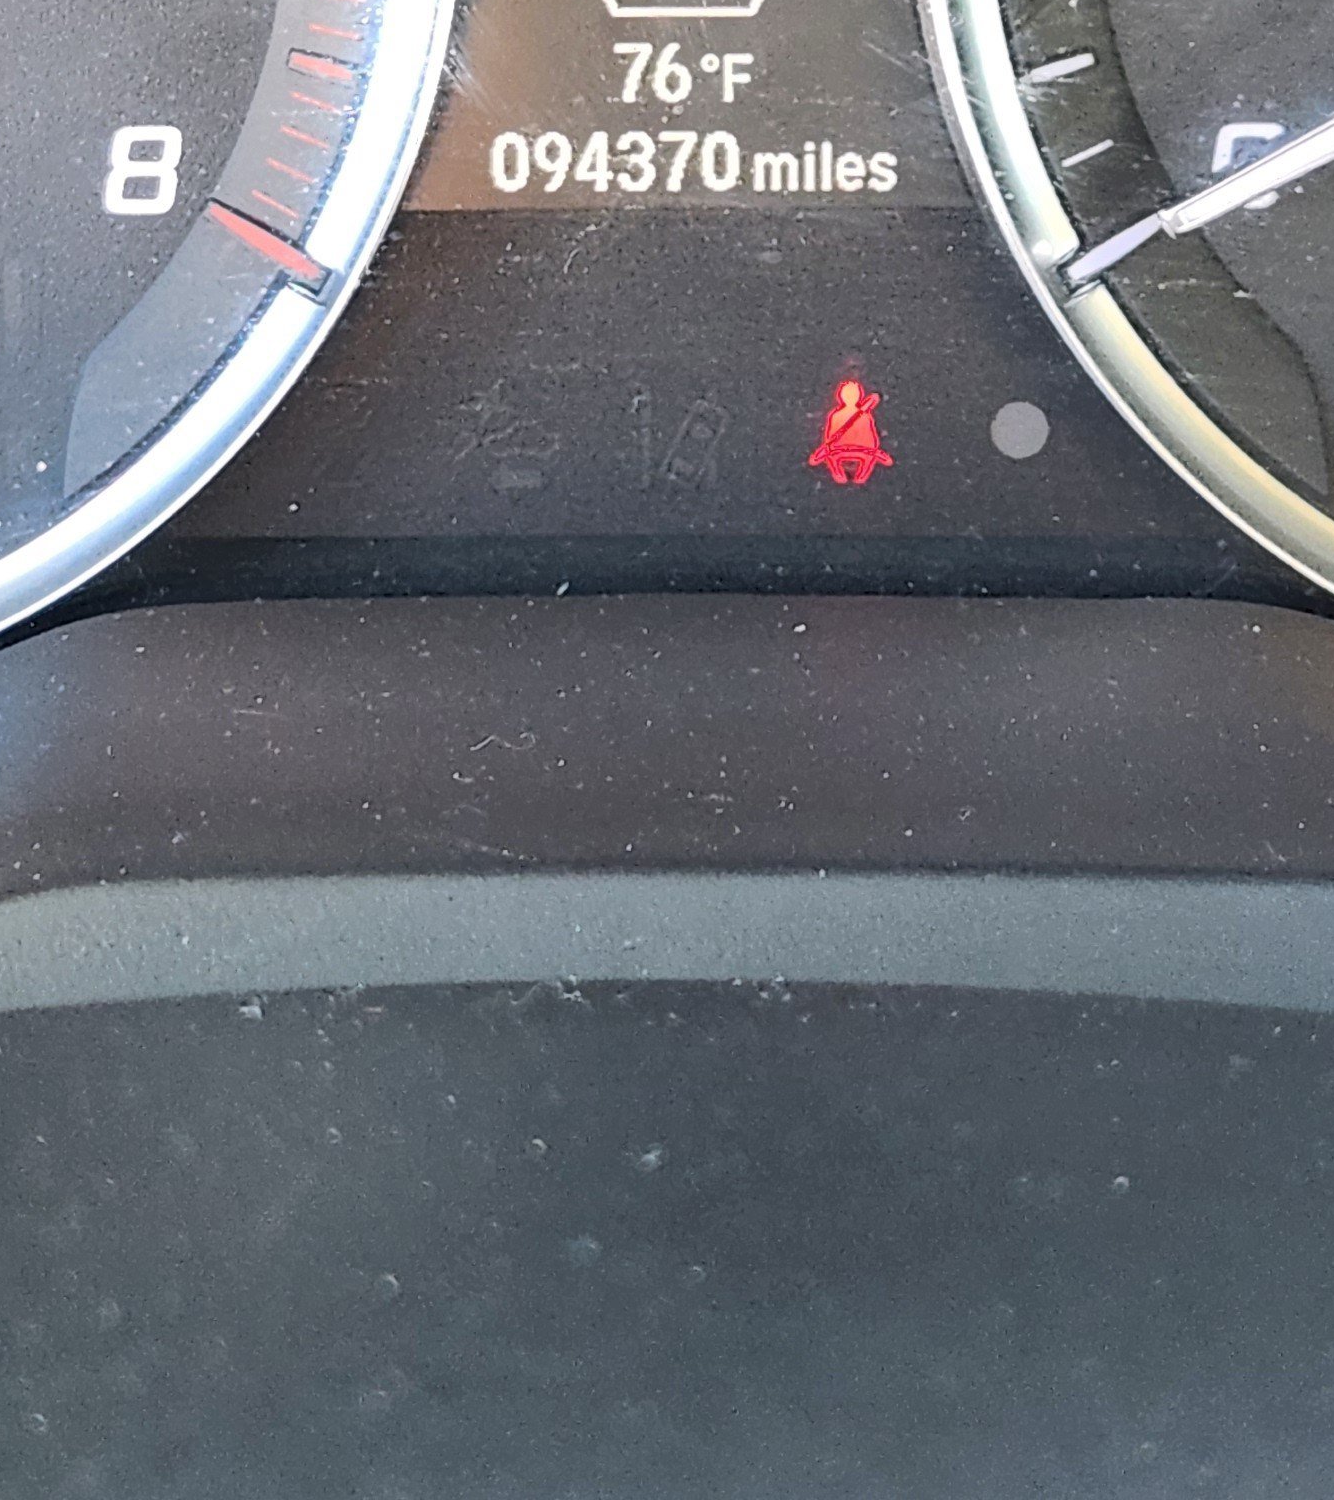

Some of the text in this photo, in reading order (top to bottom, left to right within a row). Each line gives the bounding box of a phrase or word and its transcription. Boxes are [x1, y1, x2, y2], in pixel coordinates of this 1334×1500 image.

[103, 125, 182, 215] 8
[490, 131, 897, 192] 094370 miles
